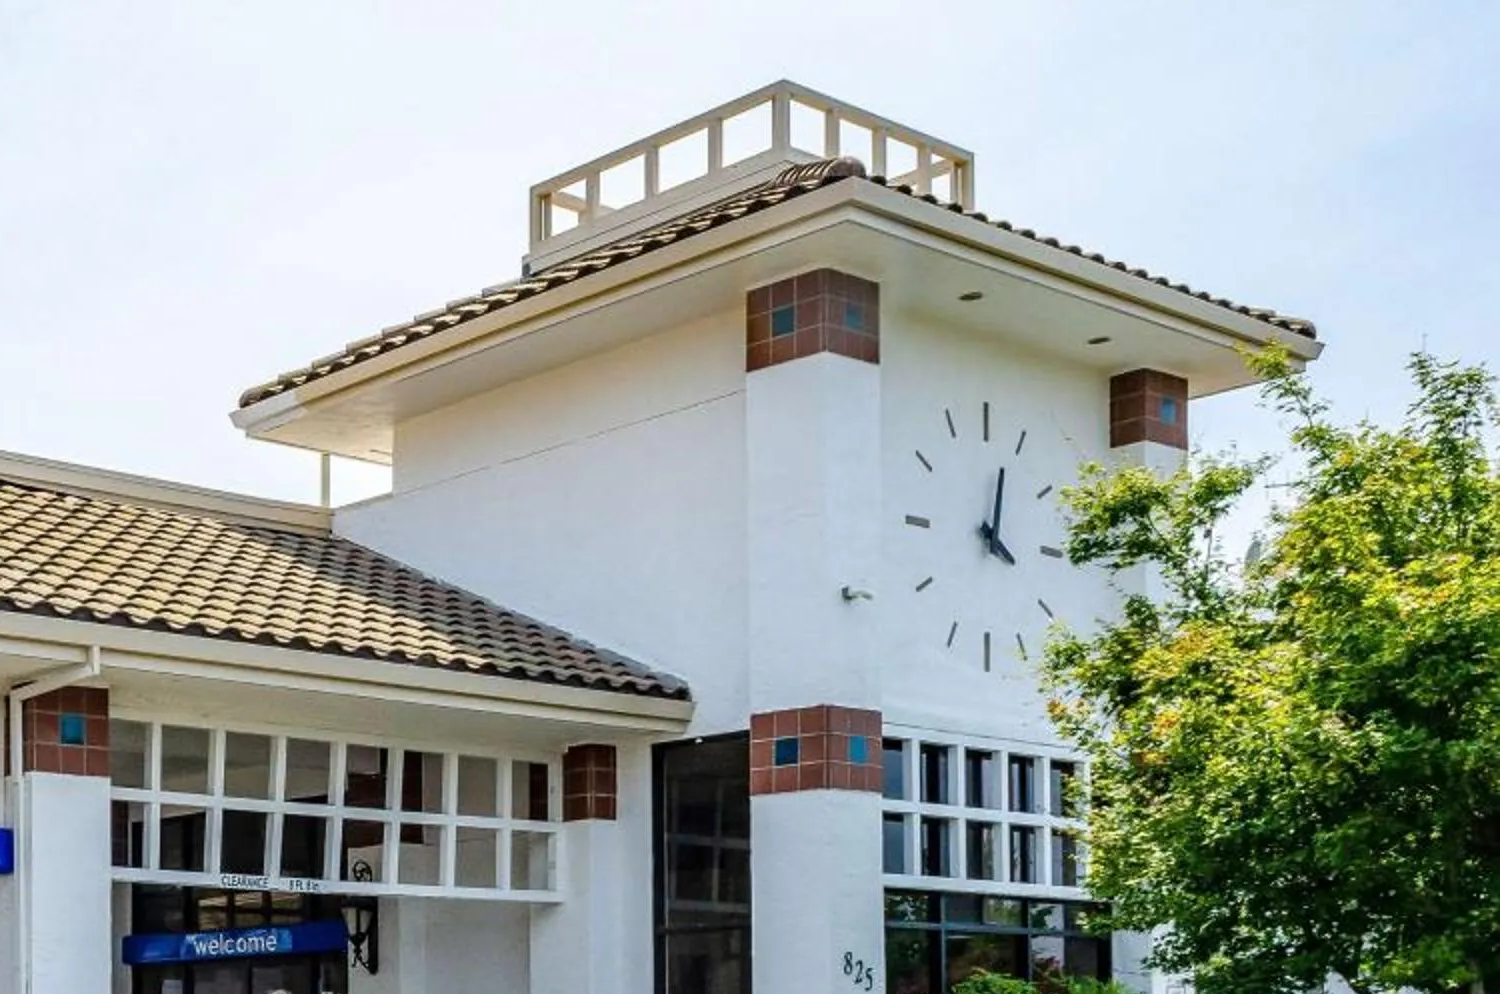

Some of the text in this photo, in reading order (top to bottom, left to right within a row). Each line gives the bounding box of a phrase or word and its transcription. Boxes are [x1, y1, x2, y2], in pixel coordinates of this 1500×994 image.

[221, 875, 269, 889] CLEARANCE
[194, 932, 277, 956] welcome
[843, 951, 873, 991] 825
